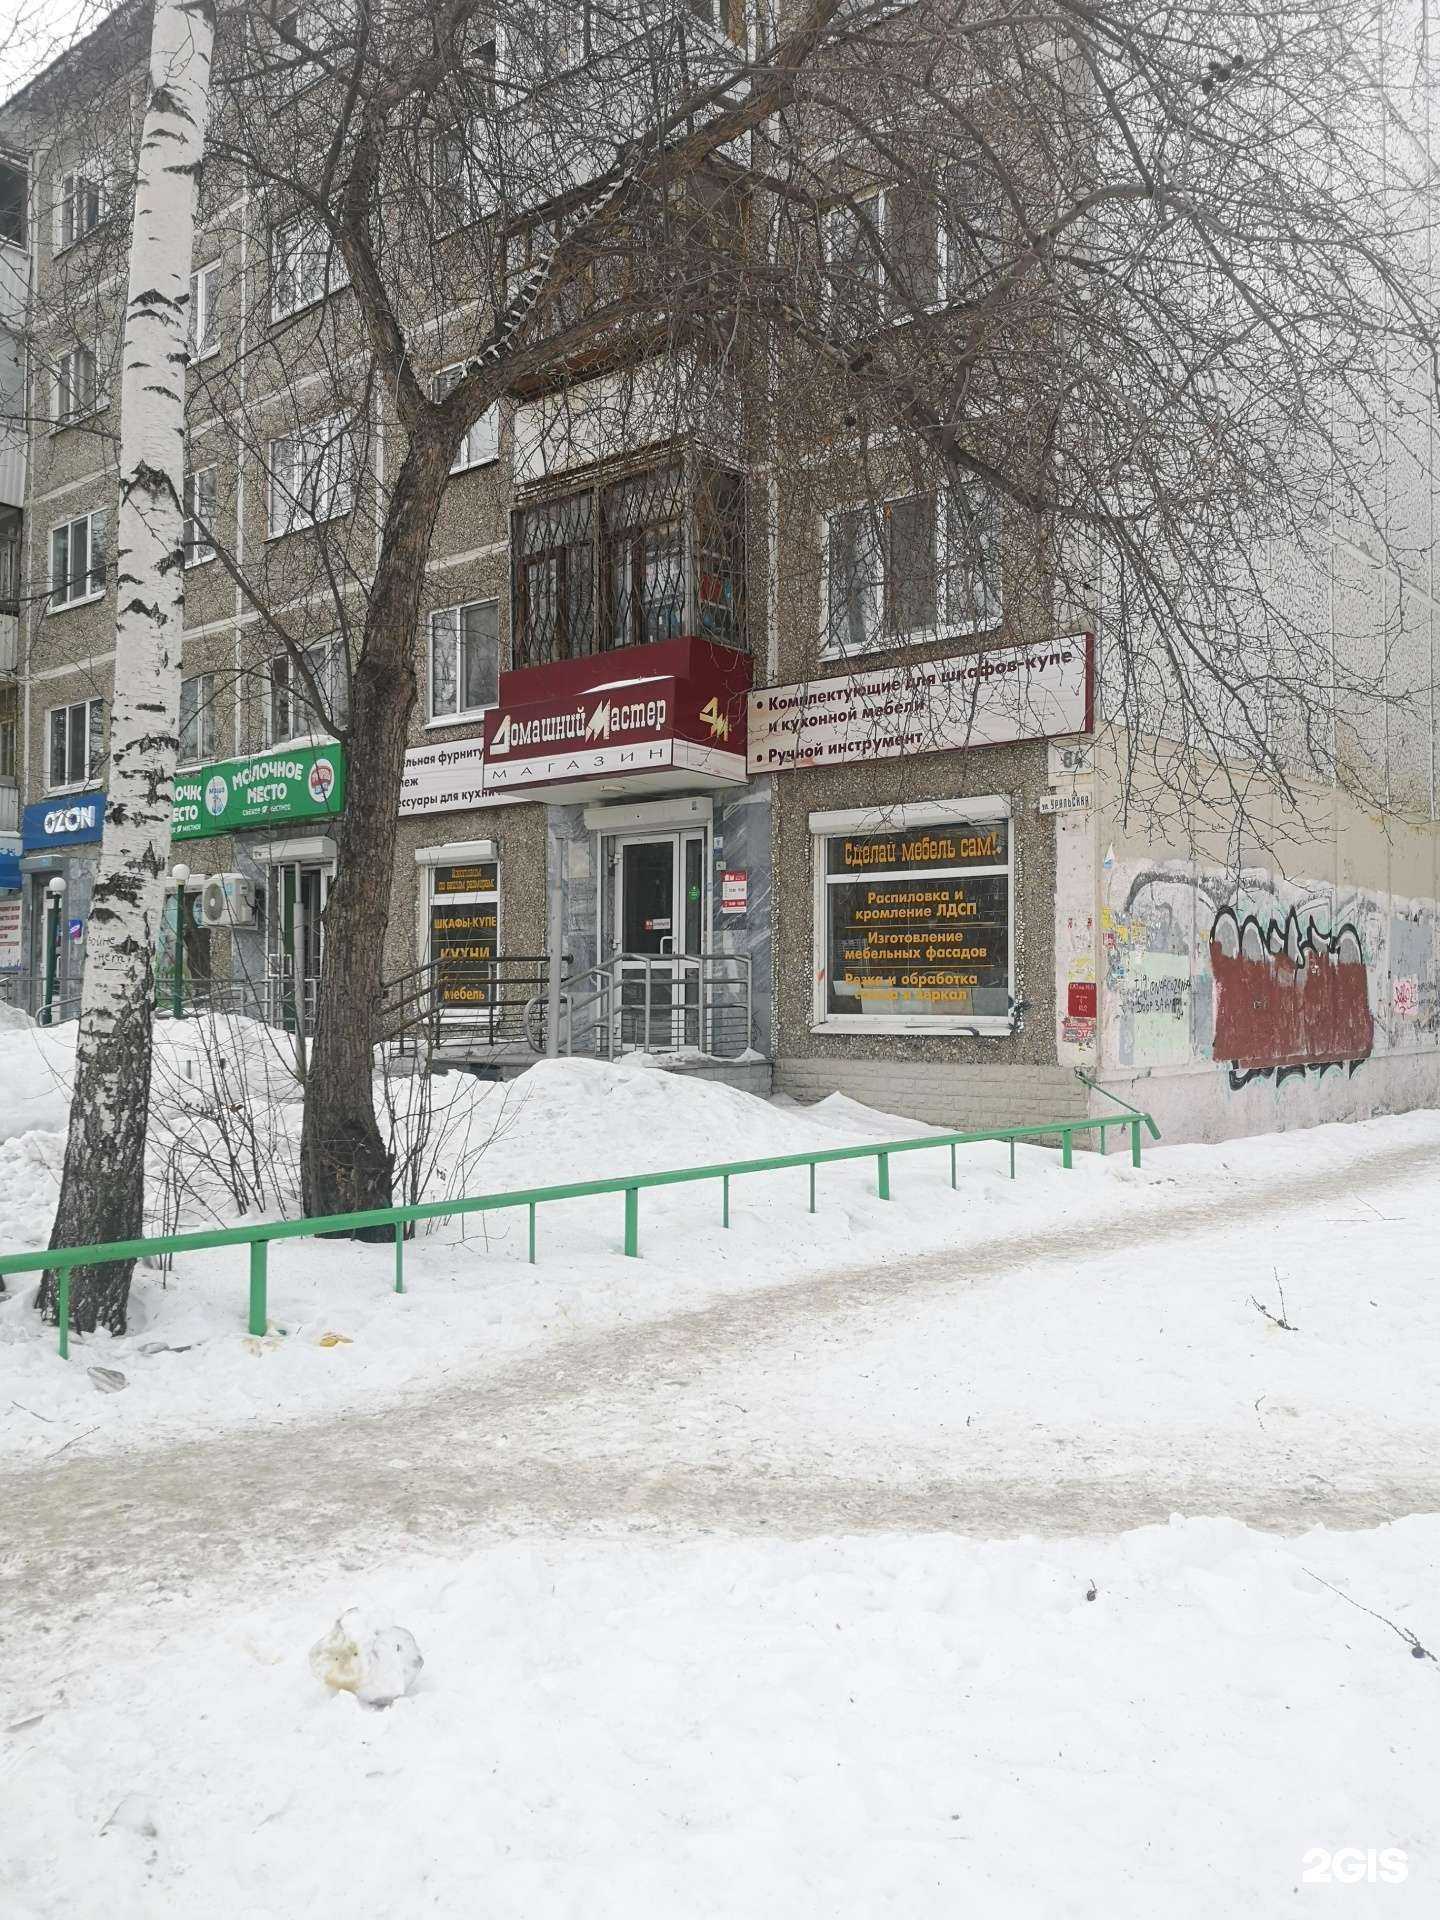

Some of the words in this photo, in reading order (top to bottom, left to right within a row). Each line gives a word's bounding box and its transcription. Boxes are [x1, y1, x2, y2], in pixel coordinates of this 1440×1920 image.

[769, 678, 901, 711] Комплектующие
[941, 650, 1073, 683] шкафов-купе
[490, 706, 587, 756] Домашний
[585, 698, 667, 743] Мастер
[768, 721, 778, 734] и
[781, 707, 858, 734] кухонной
[862, 699, 926, 719] мебели
[768, 743, 824, 766] Ручной
[828, 732, 923, 754] инструмент
[492, 748, 663, 779] МАГАЗИН
[232, 760, 304, 791] МОЛОЧНОЕ
[247, 783, 288, 804] МЕСТО
[440, 791, 459, 804] для
[44, 805, 96, 834] OZON
[845, 840, 896, 867] Сделай
[901, 836, 956, 862] мебель
[960, 831, 998, 857] сам!
[867, 890, 950, 904] Распиловка
[954, 888, 963, 900] и
[855, 906, 932, 920] кромление
[936, 901, 977, 918] ЛДСП
[434, 915, 497, 929] ШКАФЫ-КУПЕ
[867, 931, 963, 944] Изготовление
[845, 946, 921, 960] мебельных
[925, 945, 987, 961] фасадов
[888, 975, 896, 985] и
[901, 970, 978, 987] обработка
[443, 984, 485, 1000] мебель
